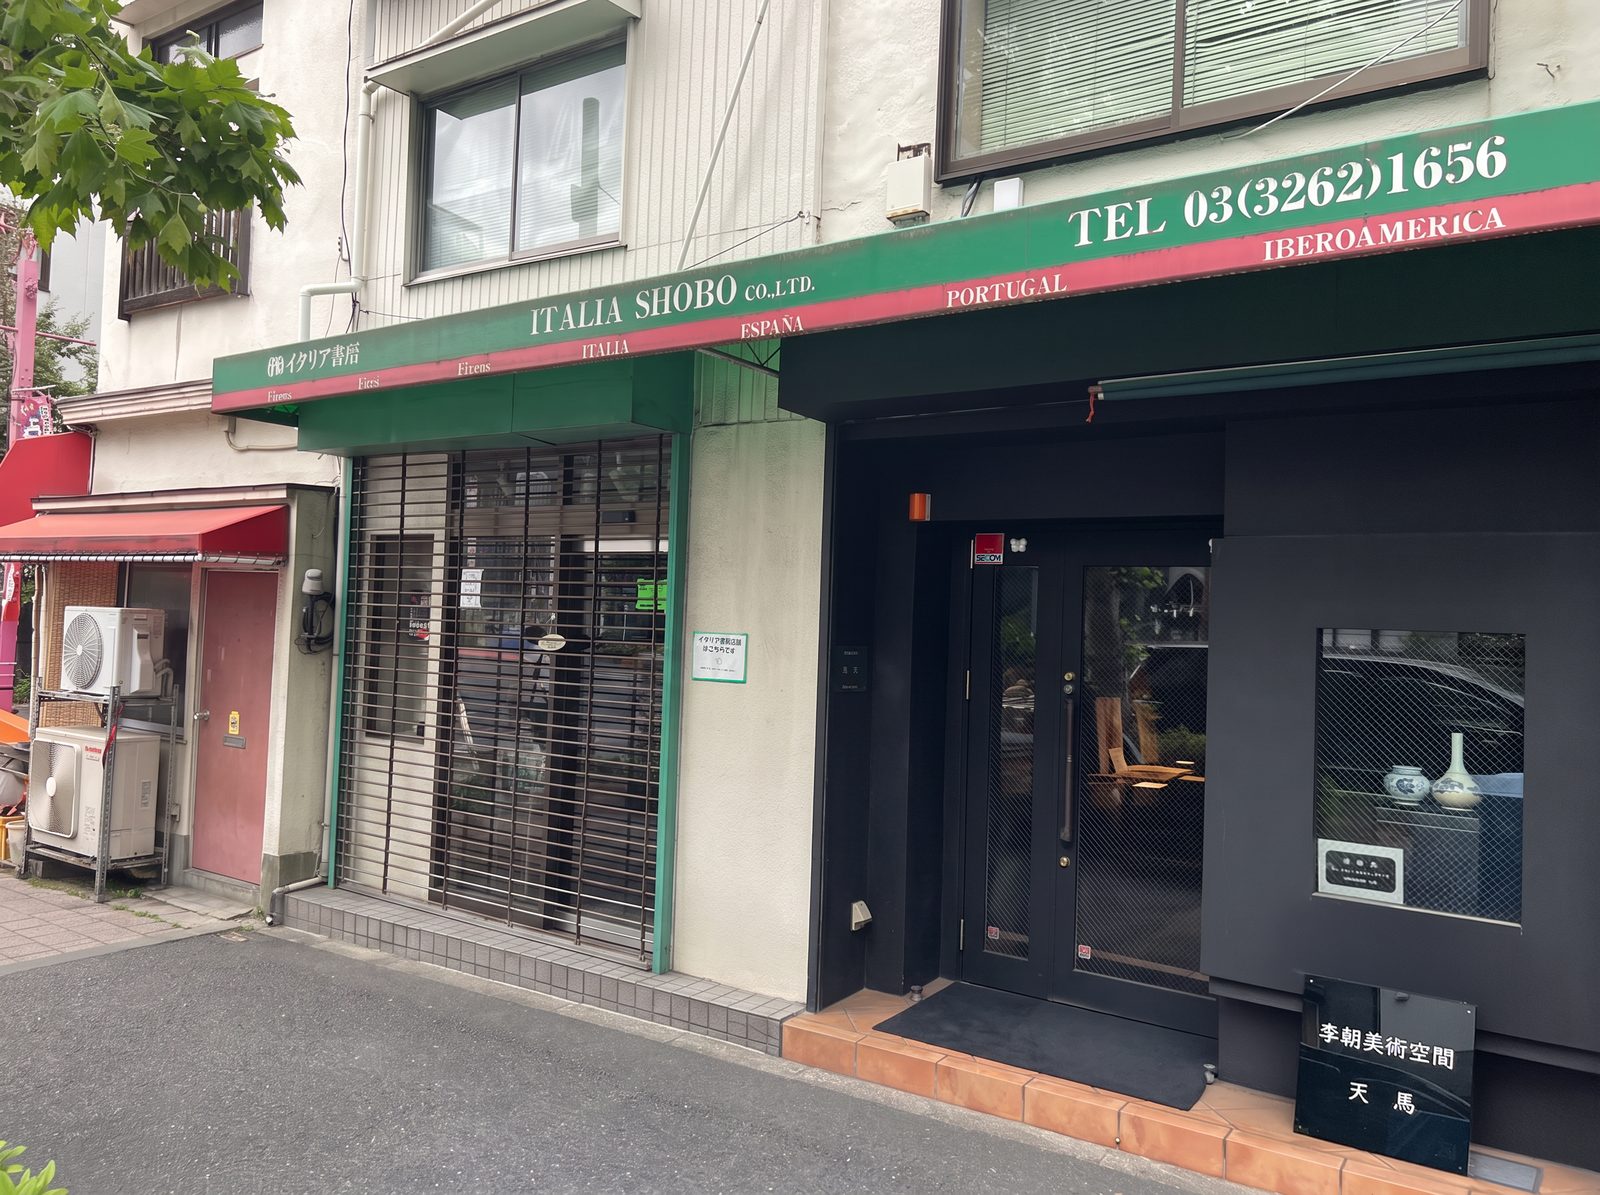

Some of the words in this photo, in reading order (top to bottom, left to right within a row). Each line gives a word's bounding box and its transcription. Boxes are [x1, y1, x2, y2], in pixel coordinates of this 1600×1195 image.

[1068, 197, 1167, 247] TEL
[1183, 135, 1508, 229] 03(3262)1656
[1263, 207, 1507, 262] IBEROAMERICA
[529, 295, 624, 336] ITALIA
[634, 274, 738, 320] SHOBO
[744, 275, 816, 301] CO.,LTD.
[946, 273, 1068, 308] PORTUGAL
[581, 338, 630, 360] ITALIA
[740, 314, 804, 340] ESPAÑA
[1318, 1022, 1455, 1070] 李朝美術空間
